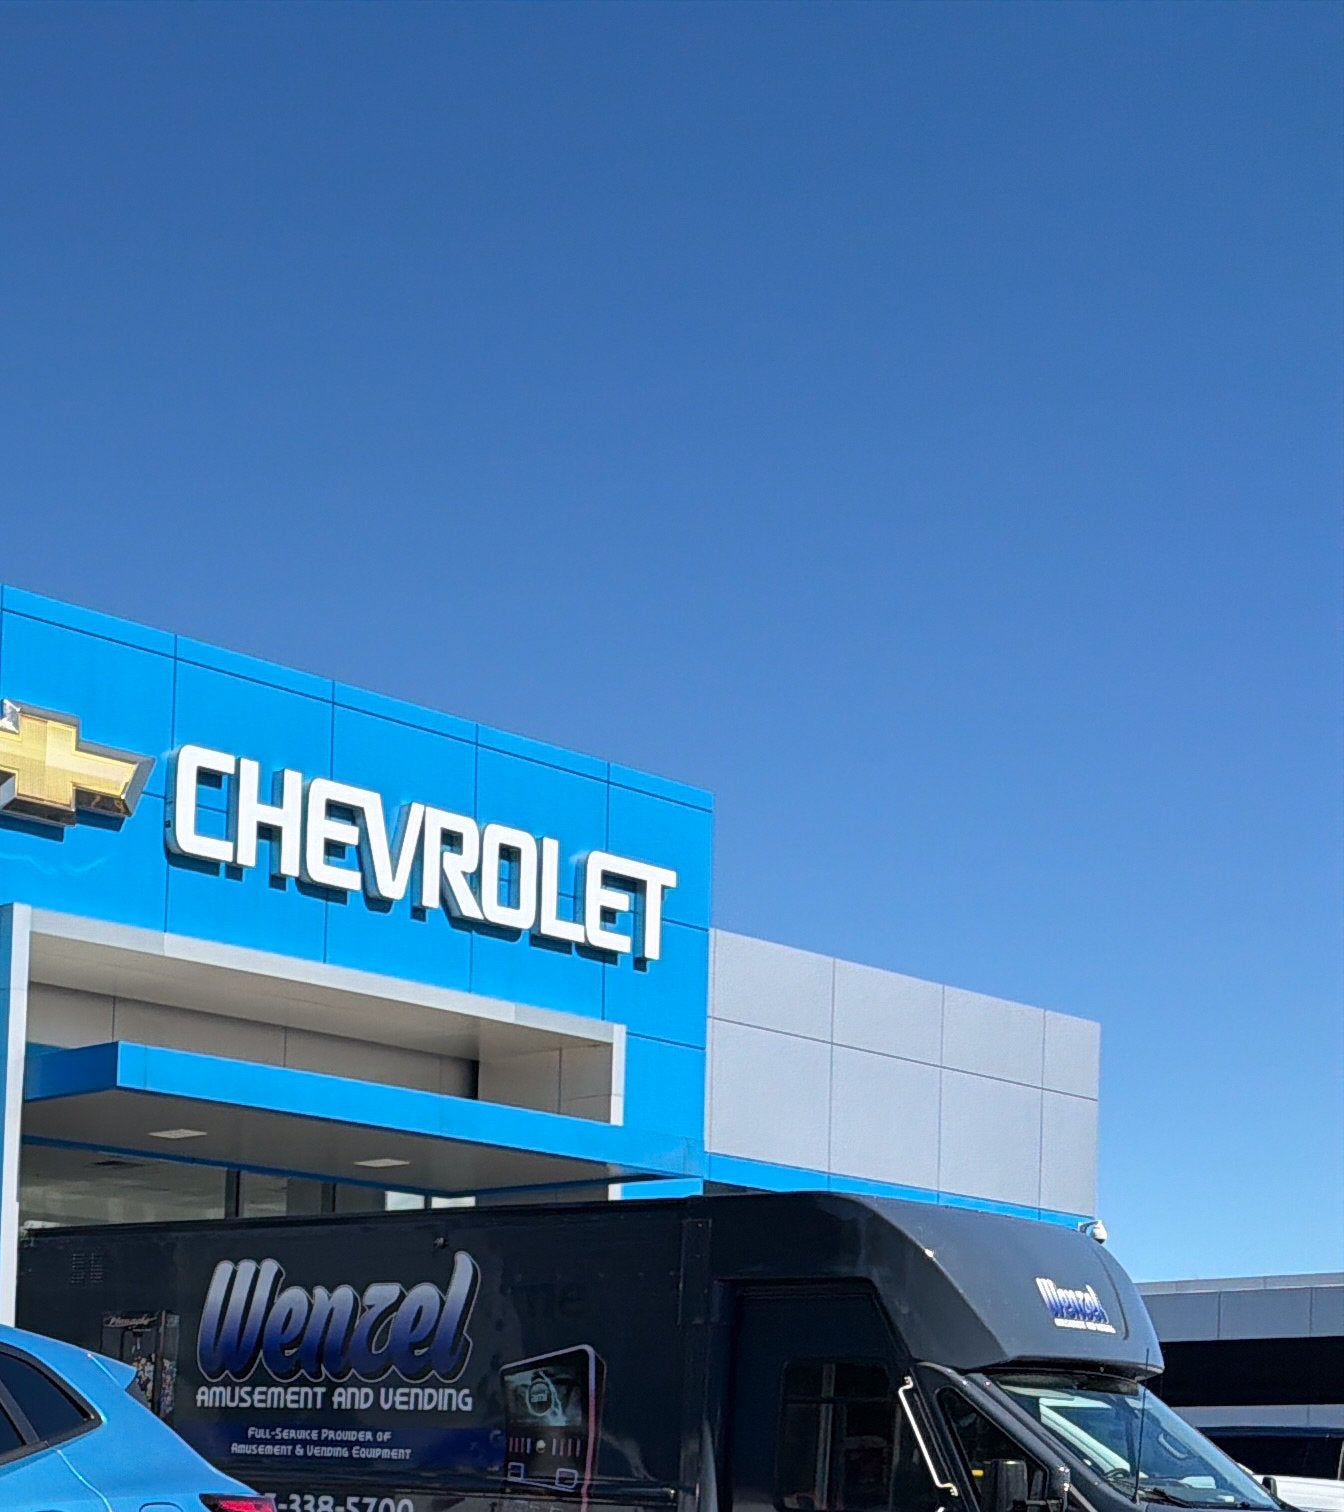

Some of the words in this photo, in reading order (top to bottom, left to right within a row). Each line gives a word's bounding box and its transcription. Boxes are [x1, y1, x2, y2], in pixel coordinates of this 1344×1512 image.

[169, 744, 677, 961] CHEVROLET
[197, 1250, 481, 1383] Wenzel
[1034, 1276, 1110, 1325] Wenzel
[195, 1385, 326, 1410] AMUSEMENT
[332, 1386, 374, 1411] AND
[379, 1387, 473, 1412] VENDING
[294, 1444, 304, 1457] &
